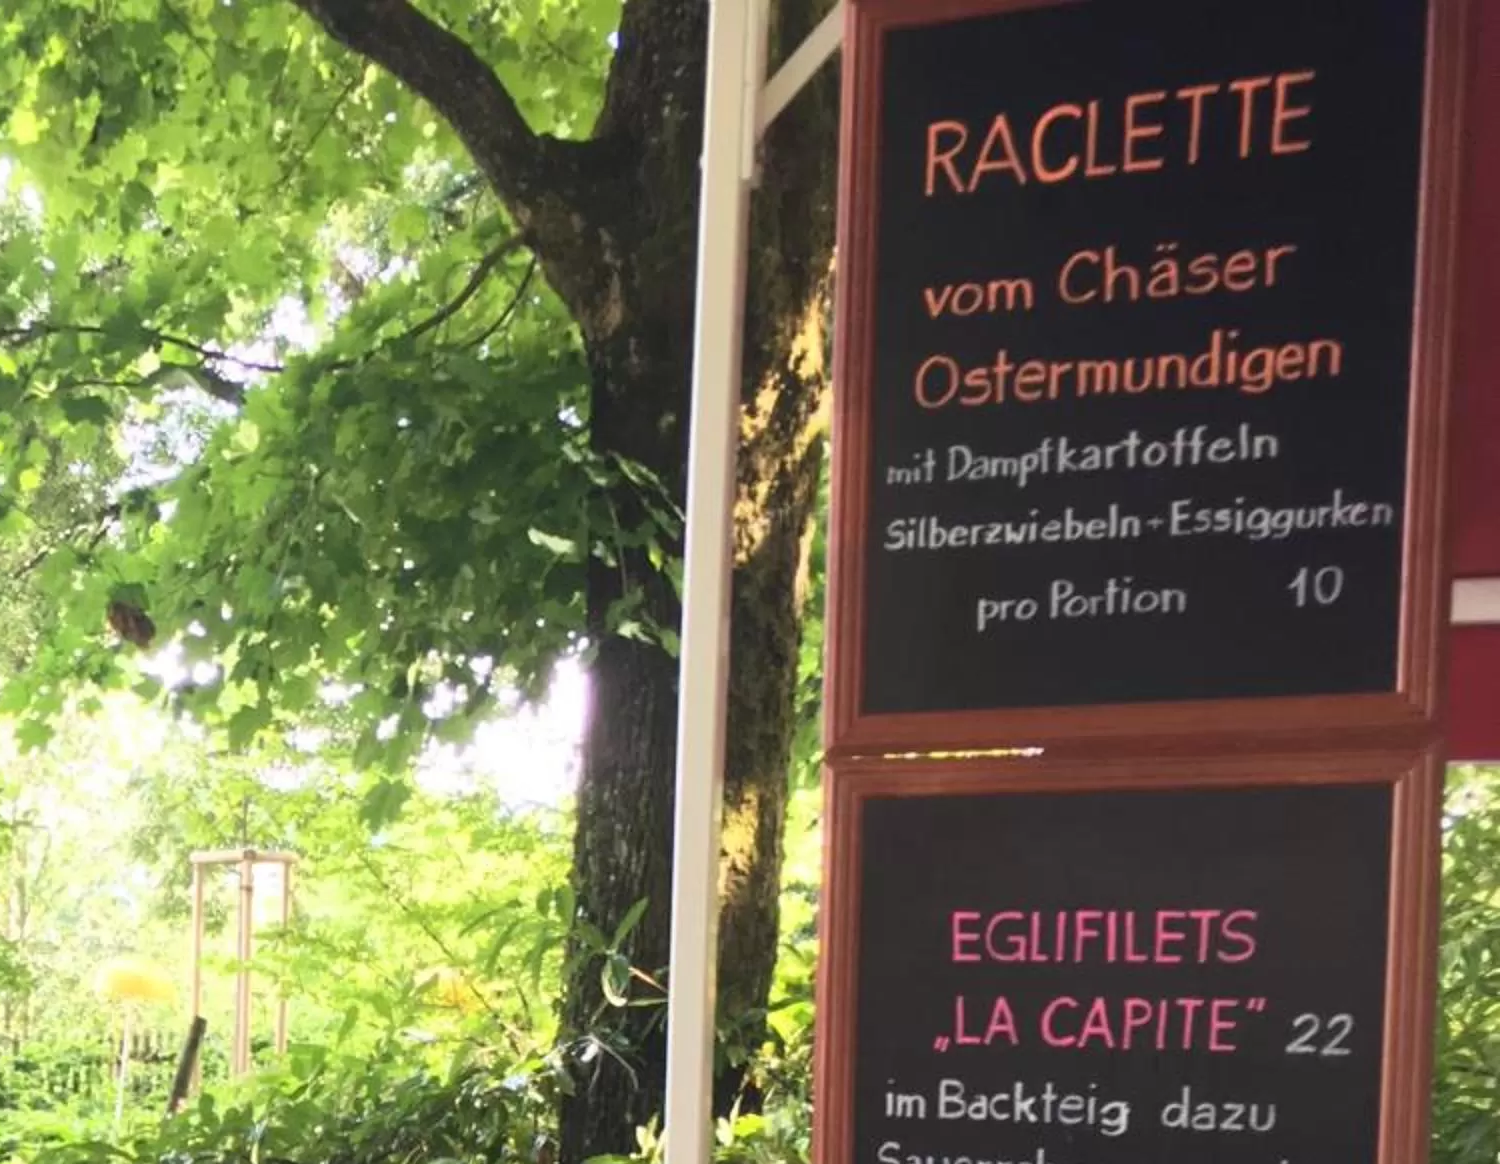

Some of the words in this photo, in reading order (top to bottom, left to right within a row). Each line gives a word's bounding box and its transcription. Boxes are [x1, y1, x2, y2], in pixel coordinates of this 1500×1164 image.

[924, 70, 1316, 197] RACLETTE
[923, 278, 1034, 318] vom
[1059, 242, 1297, 303] Chäser
[915, 329, 1342, 408] Ostermundigen
[886, 449, 935, 484] mit
[947, 423, 1279, 487] Dampfkartoffeln
[884, 503, 1141, 550] Silberzwiebeln
[1169, 489, 1394, 540] Essiggurken
[976, 597, 1037, 632] pro
[1049, 577, 1187, 619] Portion
[1288, 566, 1344, 607] 10
[951, 910, 1258, 963] EGLIFILETS
[1285, 1013, 1354, 1056] 22
[885, 1079, 926, 1120] im
[937, 1078, 1131, 1136] Backteig
[1160, 1085, 1277, 1132] dazu
